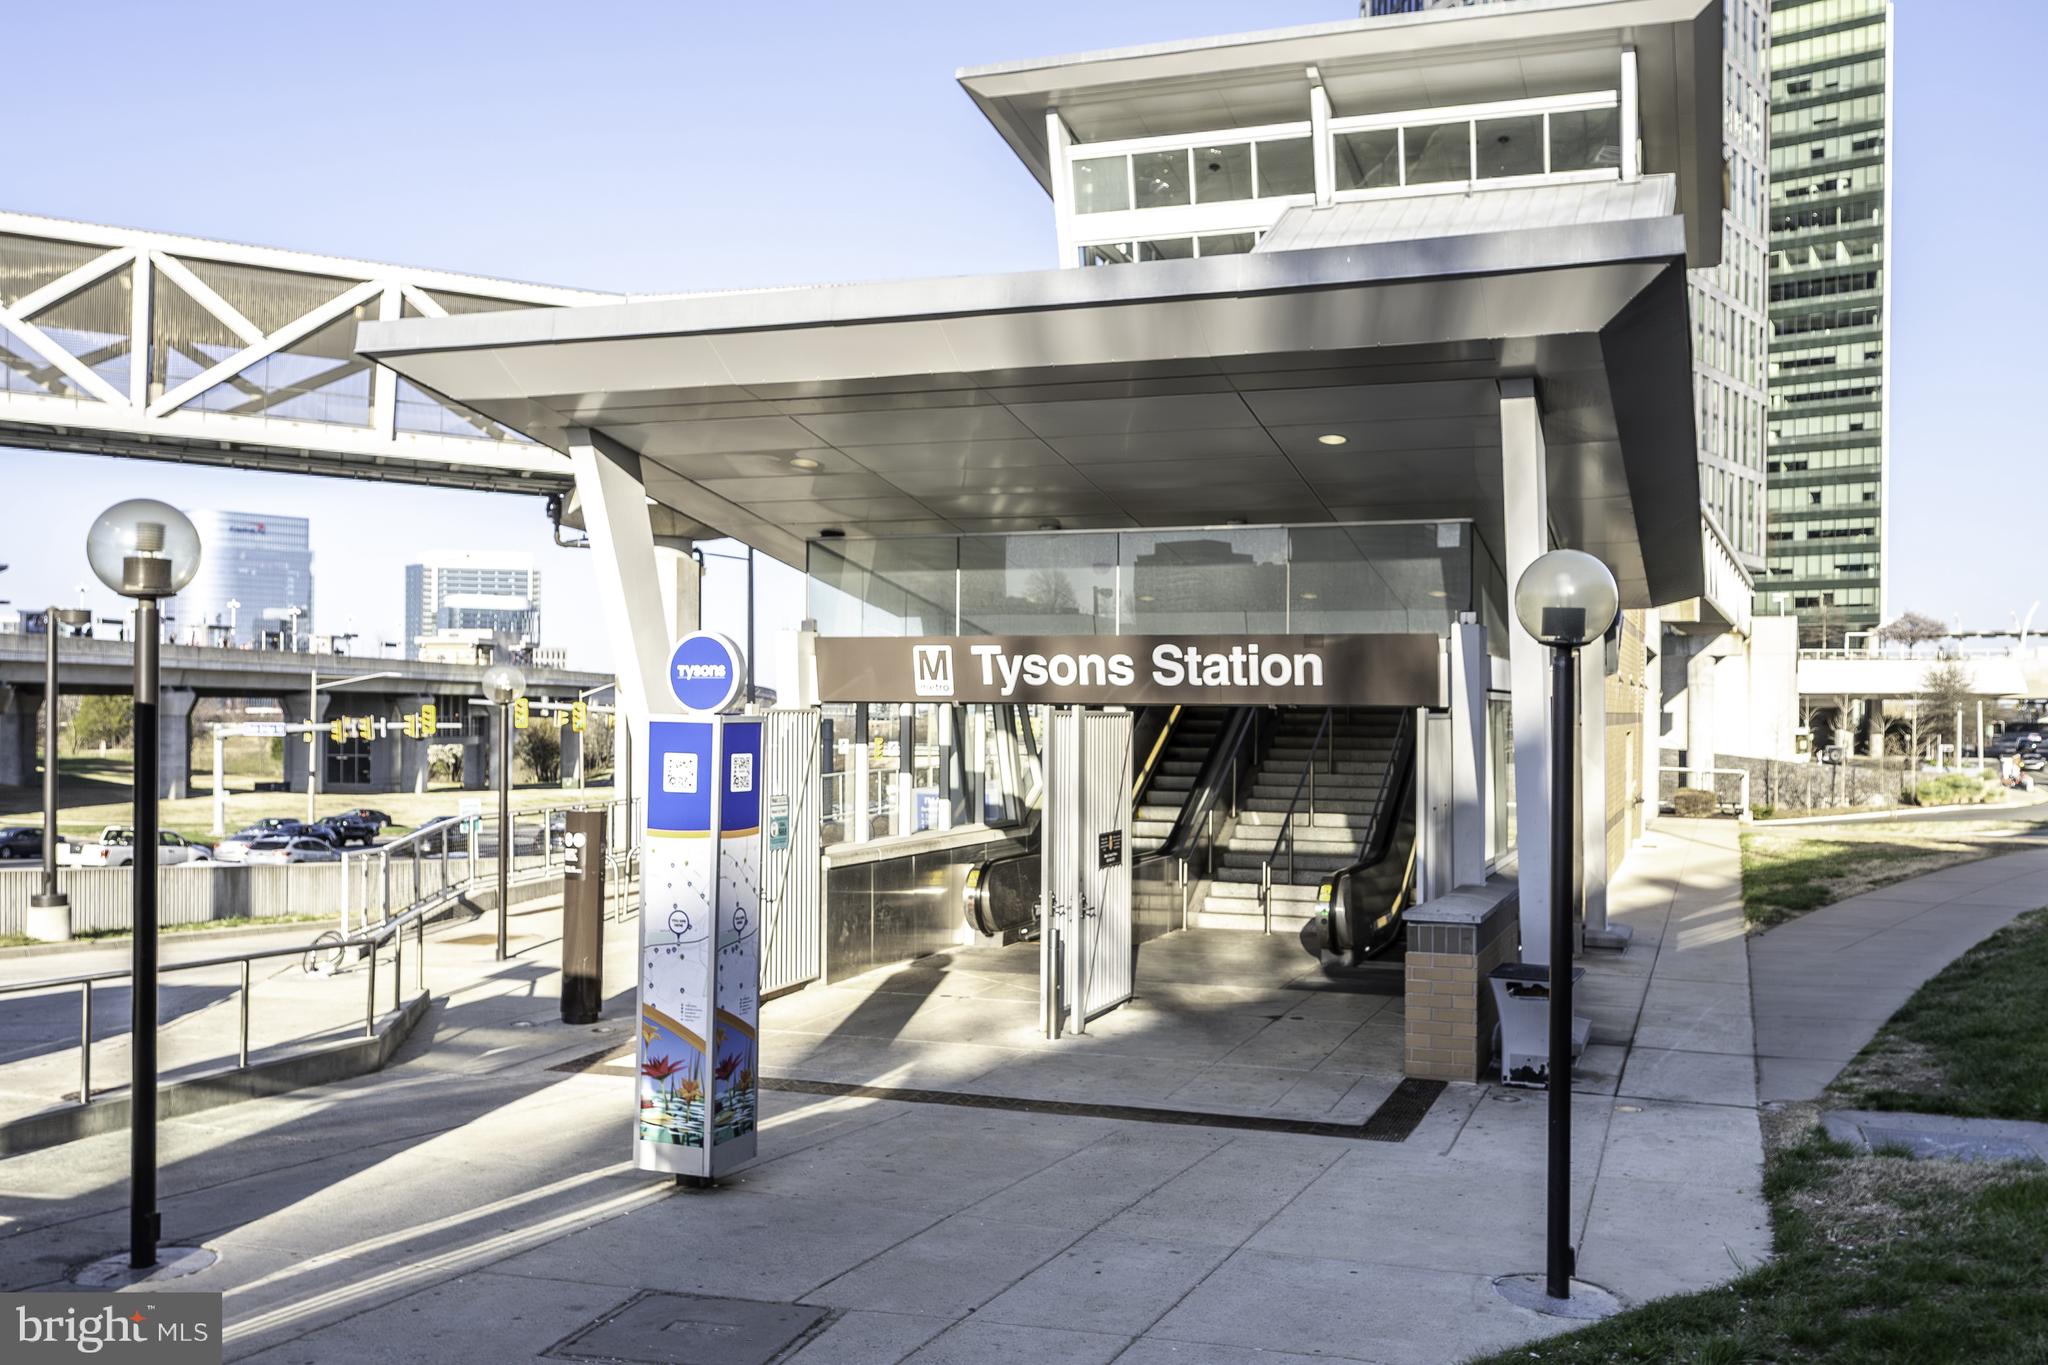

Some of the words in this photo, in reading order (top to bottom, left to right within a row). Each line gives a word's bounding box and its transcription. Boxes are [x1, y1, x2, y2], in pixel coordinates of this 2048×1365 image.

[919, 650, 948, 680] M
[970, 645, 1135, 695] Tysons
[1152, 644, 1323, 687] Station
